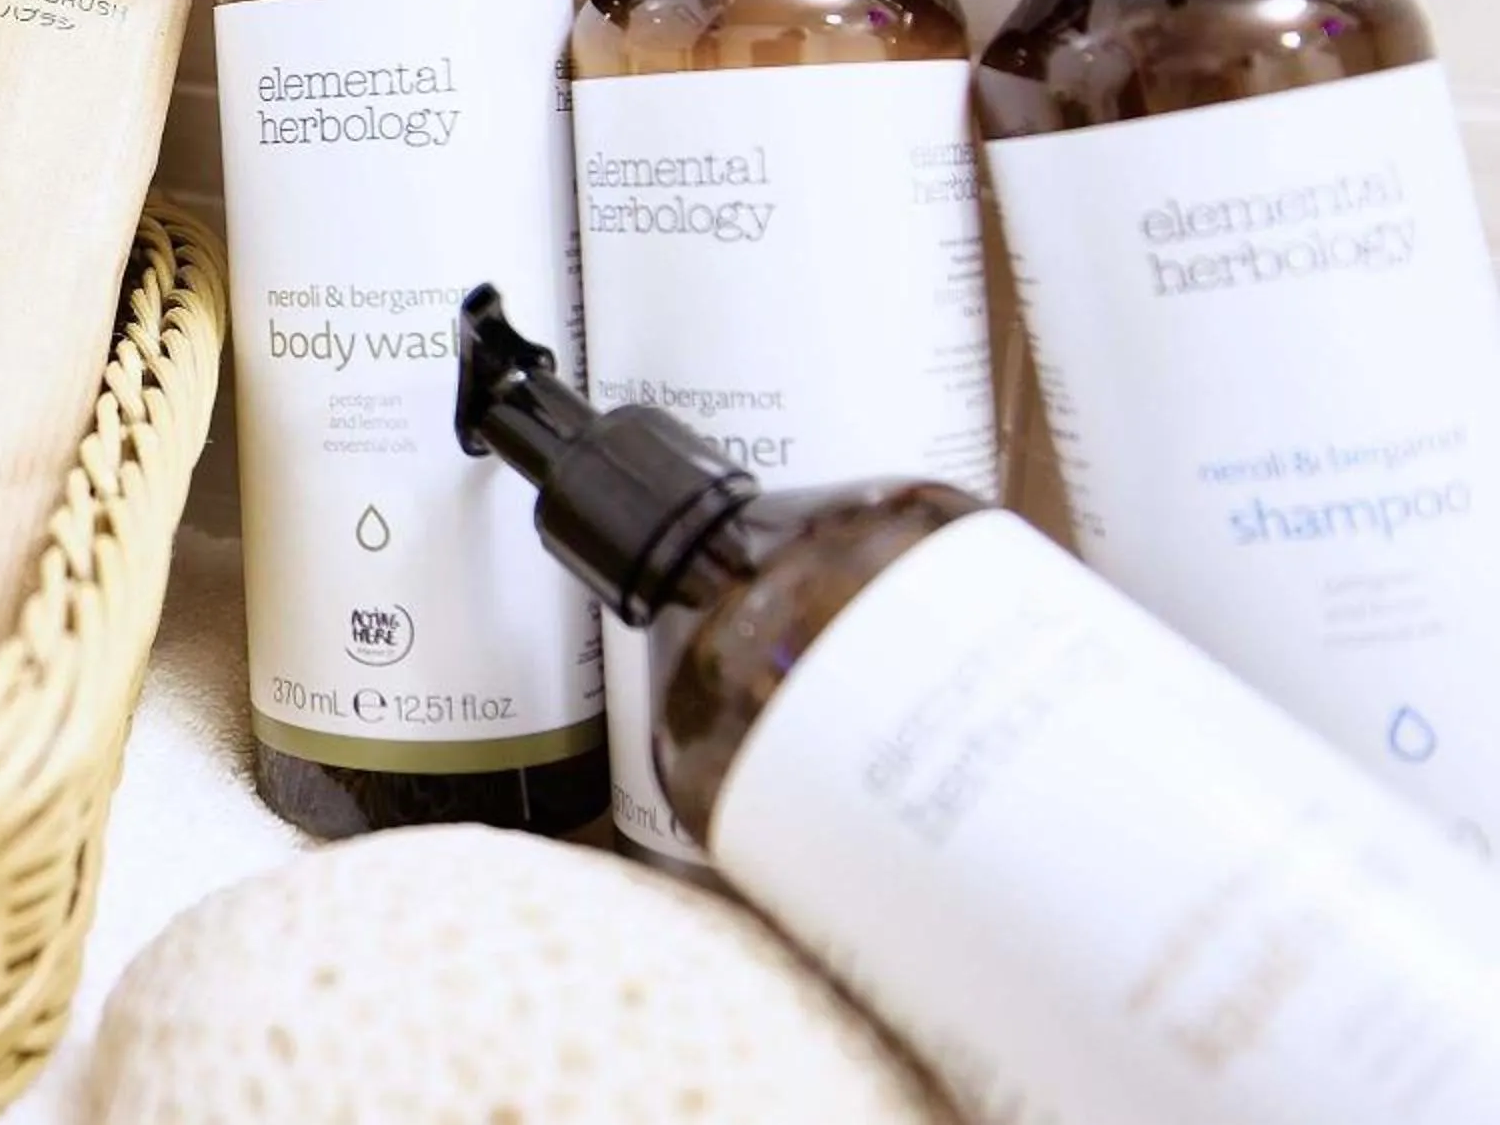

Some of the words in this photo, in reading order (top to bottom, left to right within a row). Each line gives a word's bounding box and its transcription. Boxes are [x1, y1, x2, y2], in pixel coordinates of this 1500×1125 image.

[0, 4, 77, 31] ハブラシ
[258, 58, 456, 102] elemental
[257, 106, 460, 147] herbology
[587, 147, 770, 188] elemental
[587, 195, 776, 242] herbology
[1140, 163, 1406, 247] elemental
[1147, 219, 1417, 297] herbology
[267, 285, 320, 308] neroli
[325, 285, 344, 308] &
[269, 318, 355, 372] body
[661, 382, 785, 418] bergamot
[1227, 478, 1474, 546] shampoo
[273, 678, 306, 709] 370
[311, 691, 348, 717] mL
